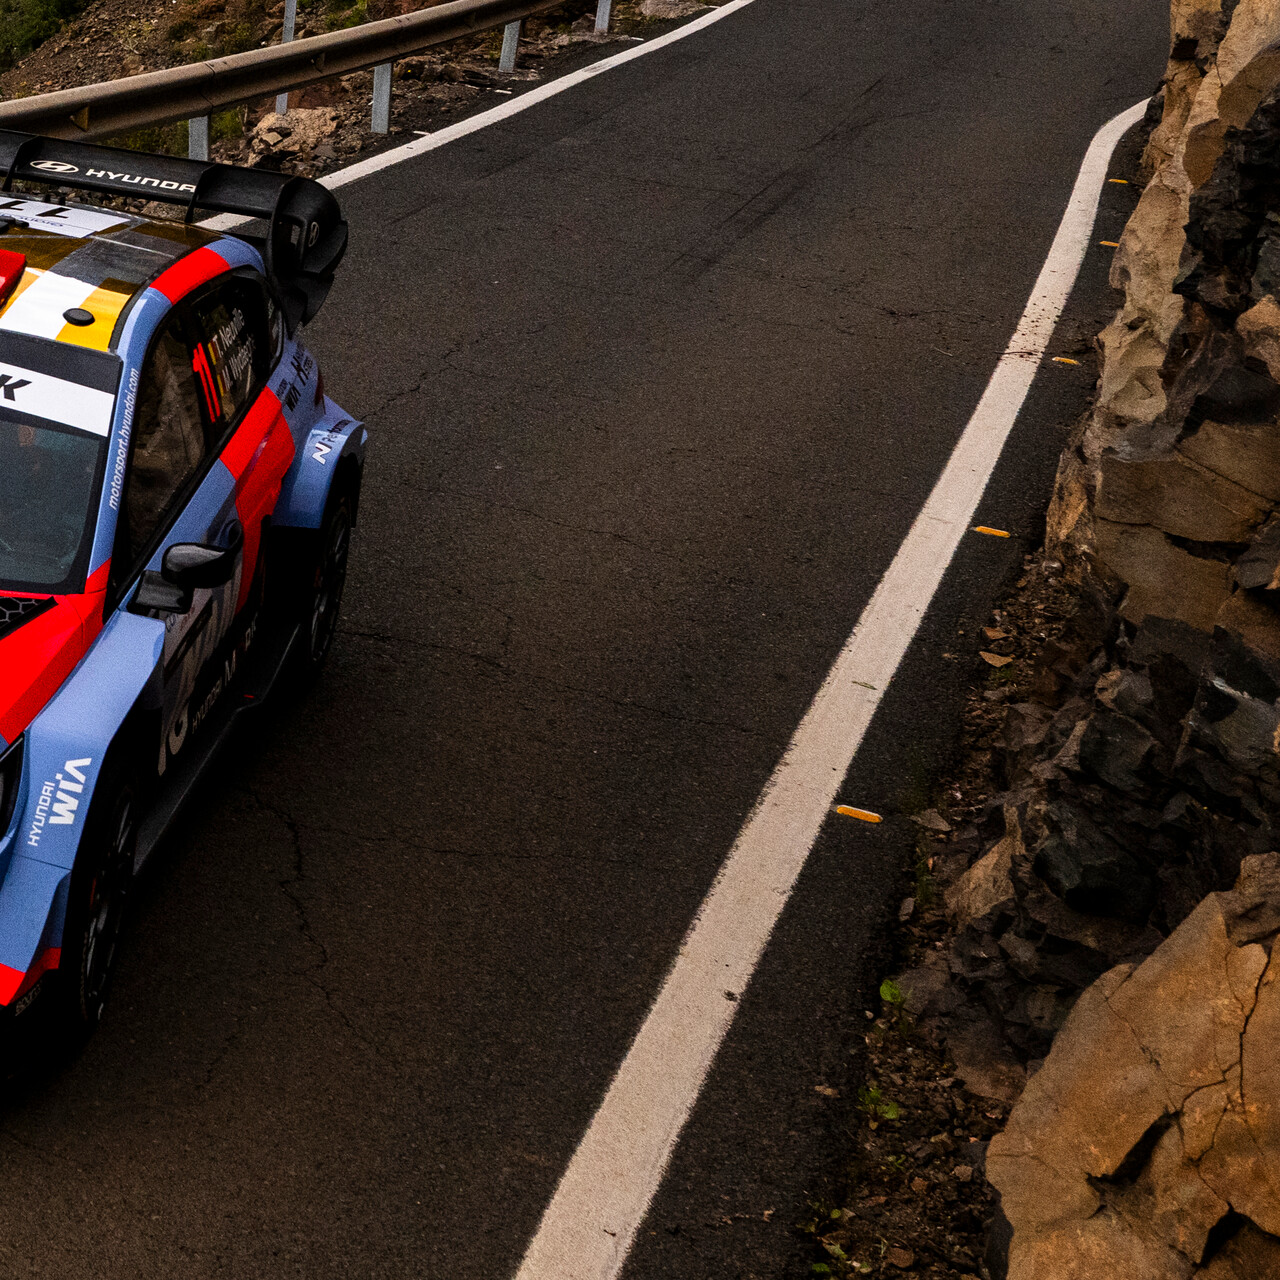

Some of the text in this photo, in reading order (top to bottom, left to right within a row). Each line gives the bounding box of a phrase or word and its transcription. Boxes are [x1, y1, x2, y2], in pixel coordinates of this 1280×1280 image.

[85, 168, 196, 193] HYUNDA
[192, 342, 220, 423] 11
[109, 368, 140, 510] motorsport.hyundai.com
[27, 781, 55, 846] HYUNDAI
